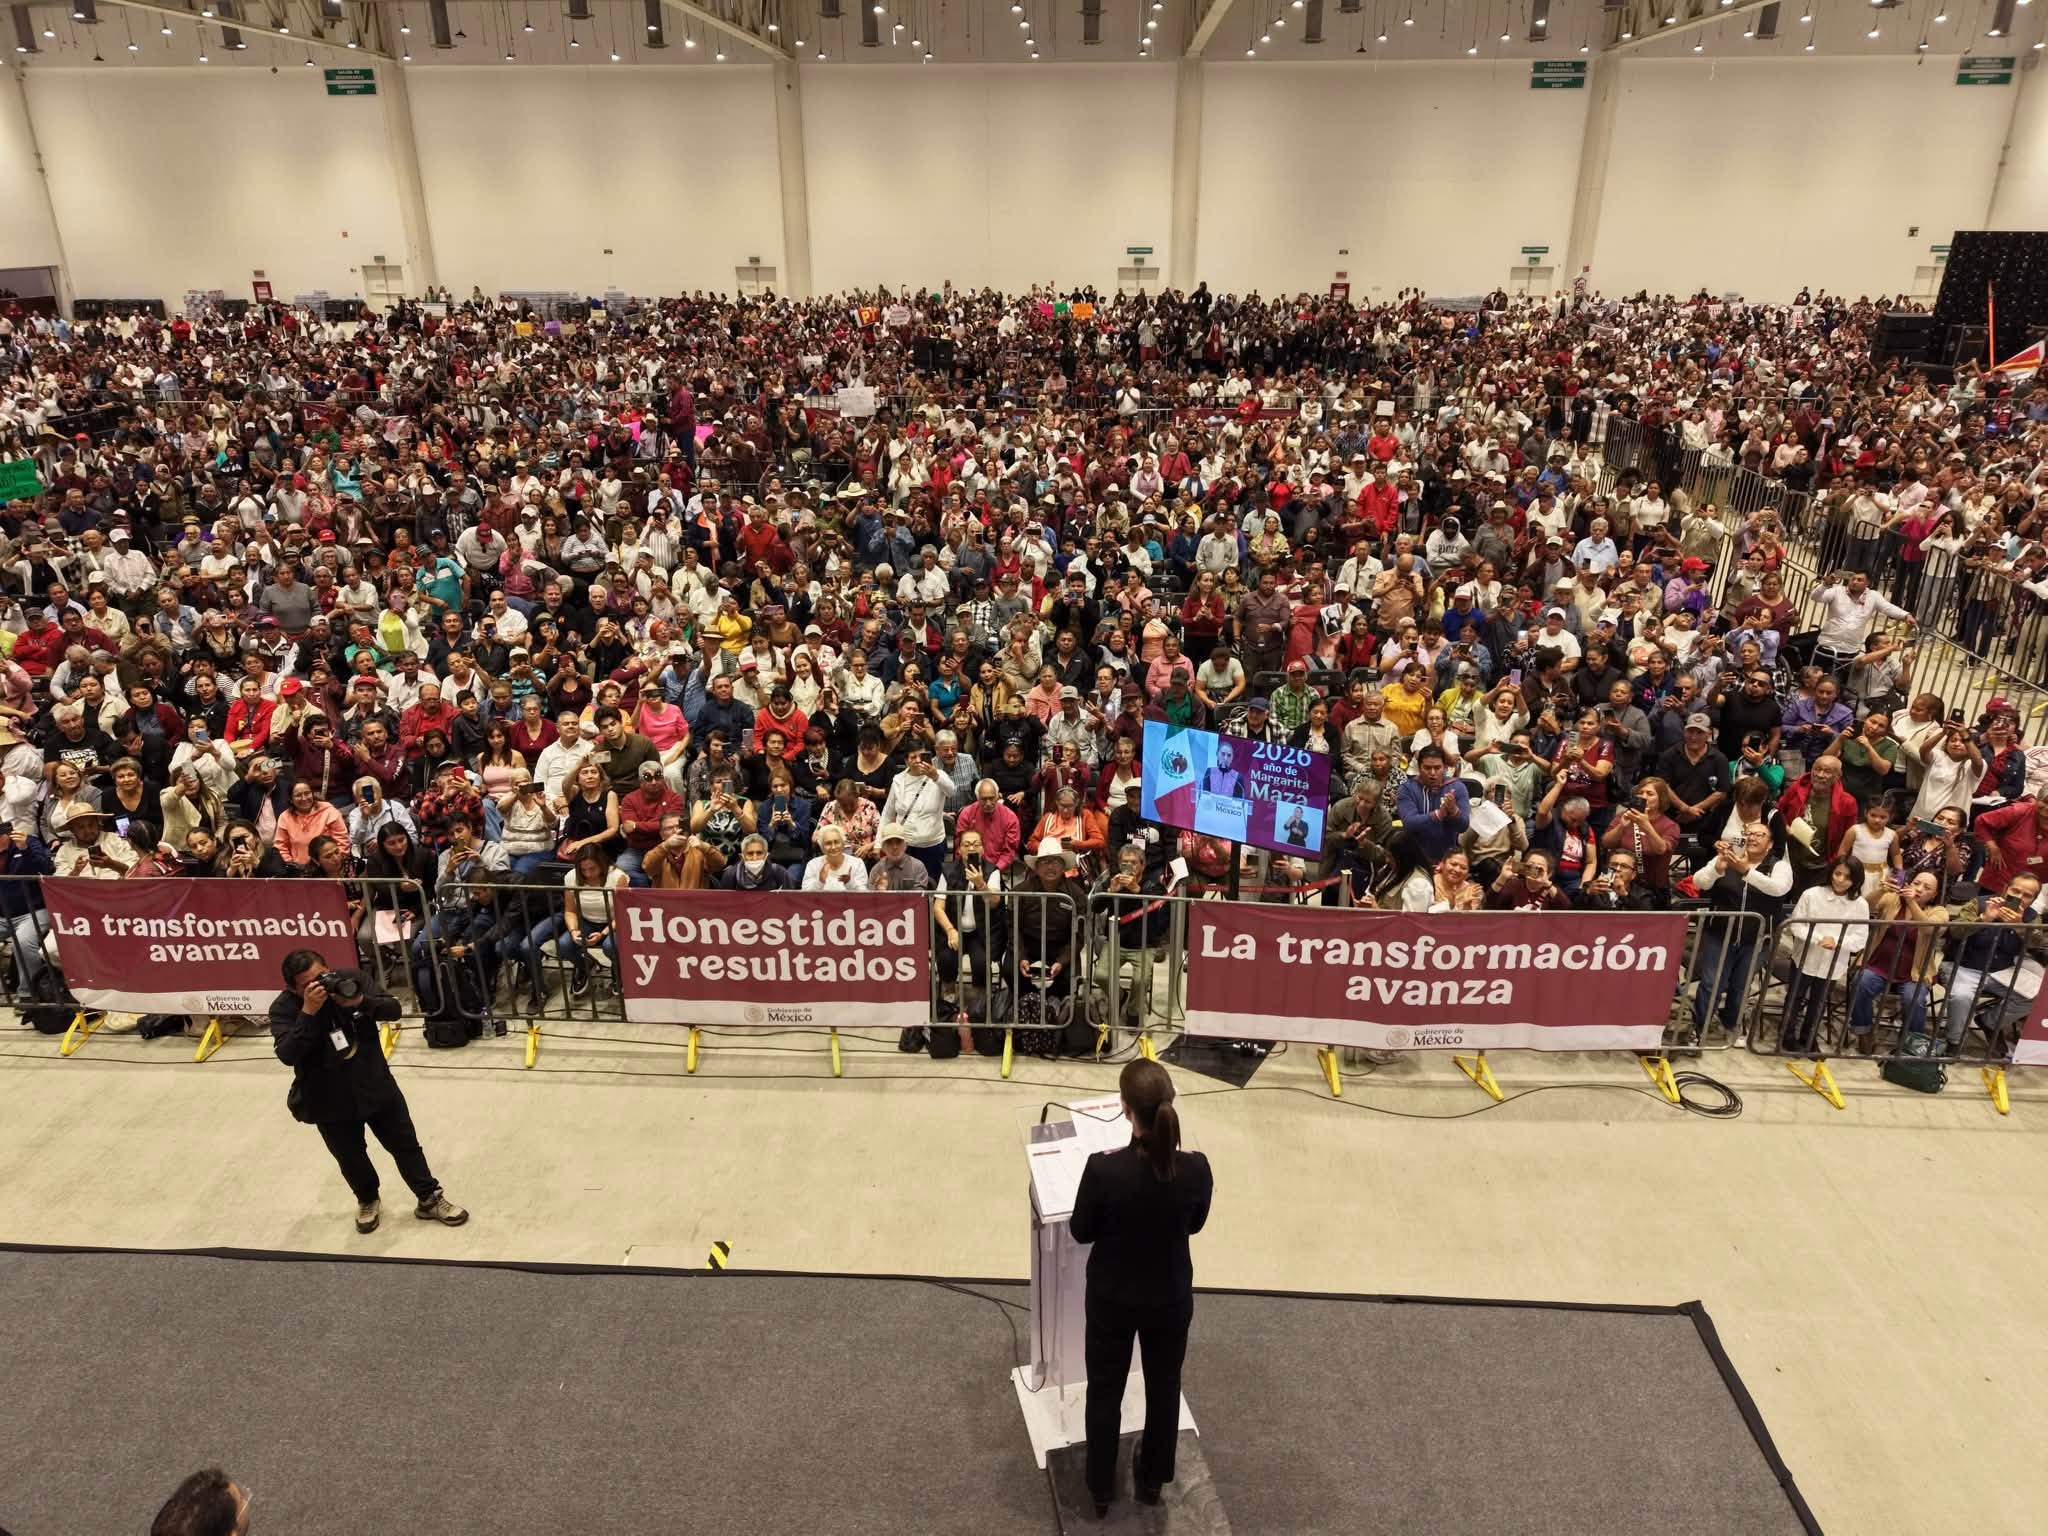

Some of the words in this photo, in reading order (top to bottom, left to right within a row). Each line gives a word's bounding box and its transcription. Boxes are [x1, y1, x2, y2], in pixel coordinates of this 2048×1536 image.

[1252, 741, 1312, 767] 2026
[1250, 769, 1309, 790] Margarita
[1263, 762, 1282, 773] año
[1285, 766, 1298, 776] de
[53, 912, 91, 936] La
[101, 911, 348, 938] transformación
[626, 907, 915, 946] Honestidad
[149, 942, 260, 962] avanza
[1201, 924, 1256, 960] La
[1276, 931, 1668, 970] transformación
[633, 954, 660, 986] y
[676, 948, 917, 982] resultados
[1345, 975, 1514, 1006] avanza
[207, 1001, 252, 1012] México
[768, 1013, 813, 1022] México
[1413, 1034, 1463, 1047] México
